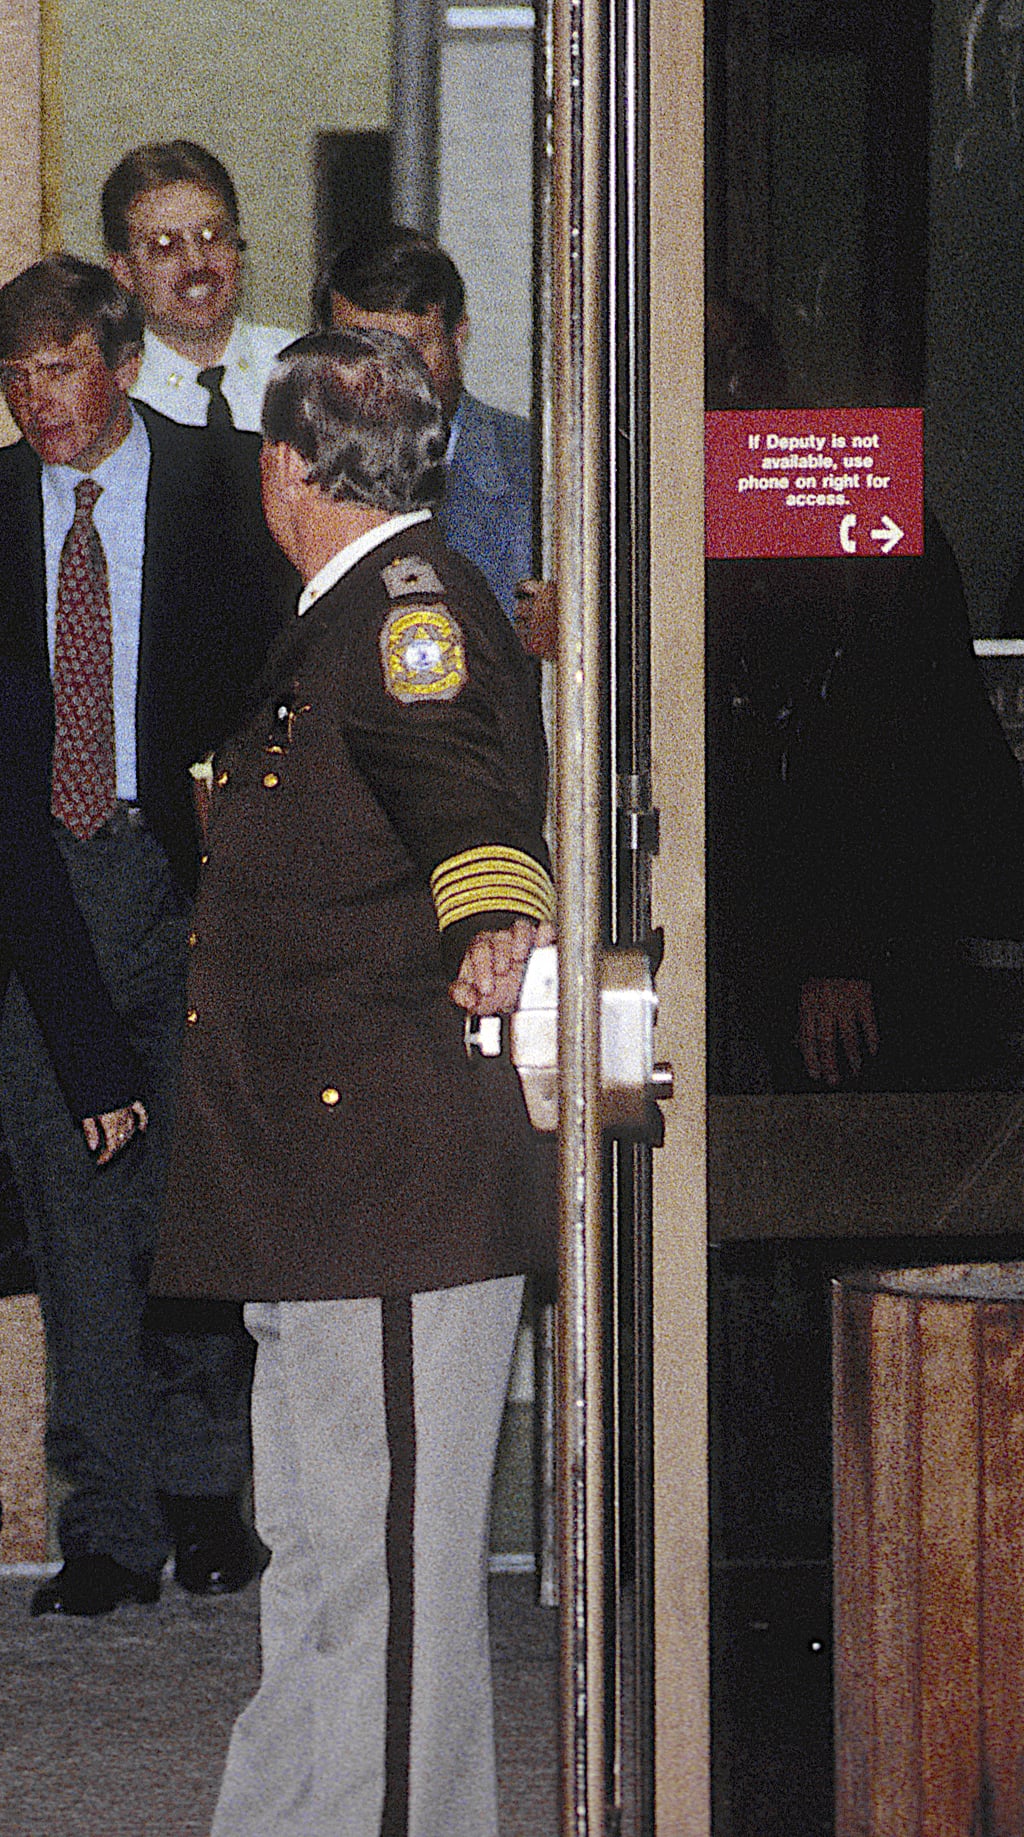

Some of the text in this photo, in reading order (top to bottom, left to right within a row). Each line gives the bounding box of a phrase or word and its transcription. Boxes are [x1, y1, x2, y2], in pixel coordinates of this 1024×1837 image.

[748, 433, 880, 451] If Deputy is not
[761, 453, 874, 471] available, use
[737, 473, 891, 492] phone on right for
[785, 493, 851, 507] access.
